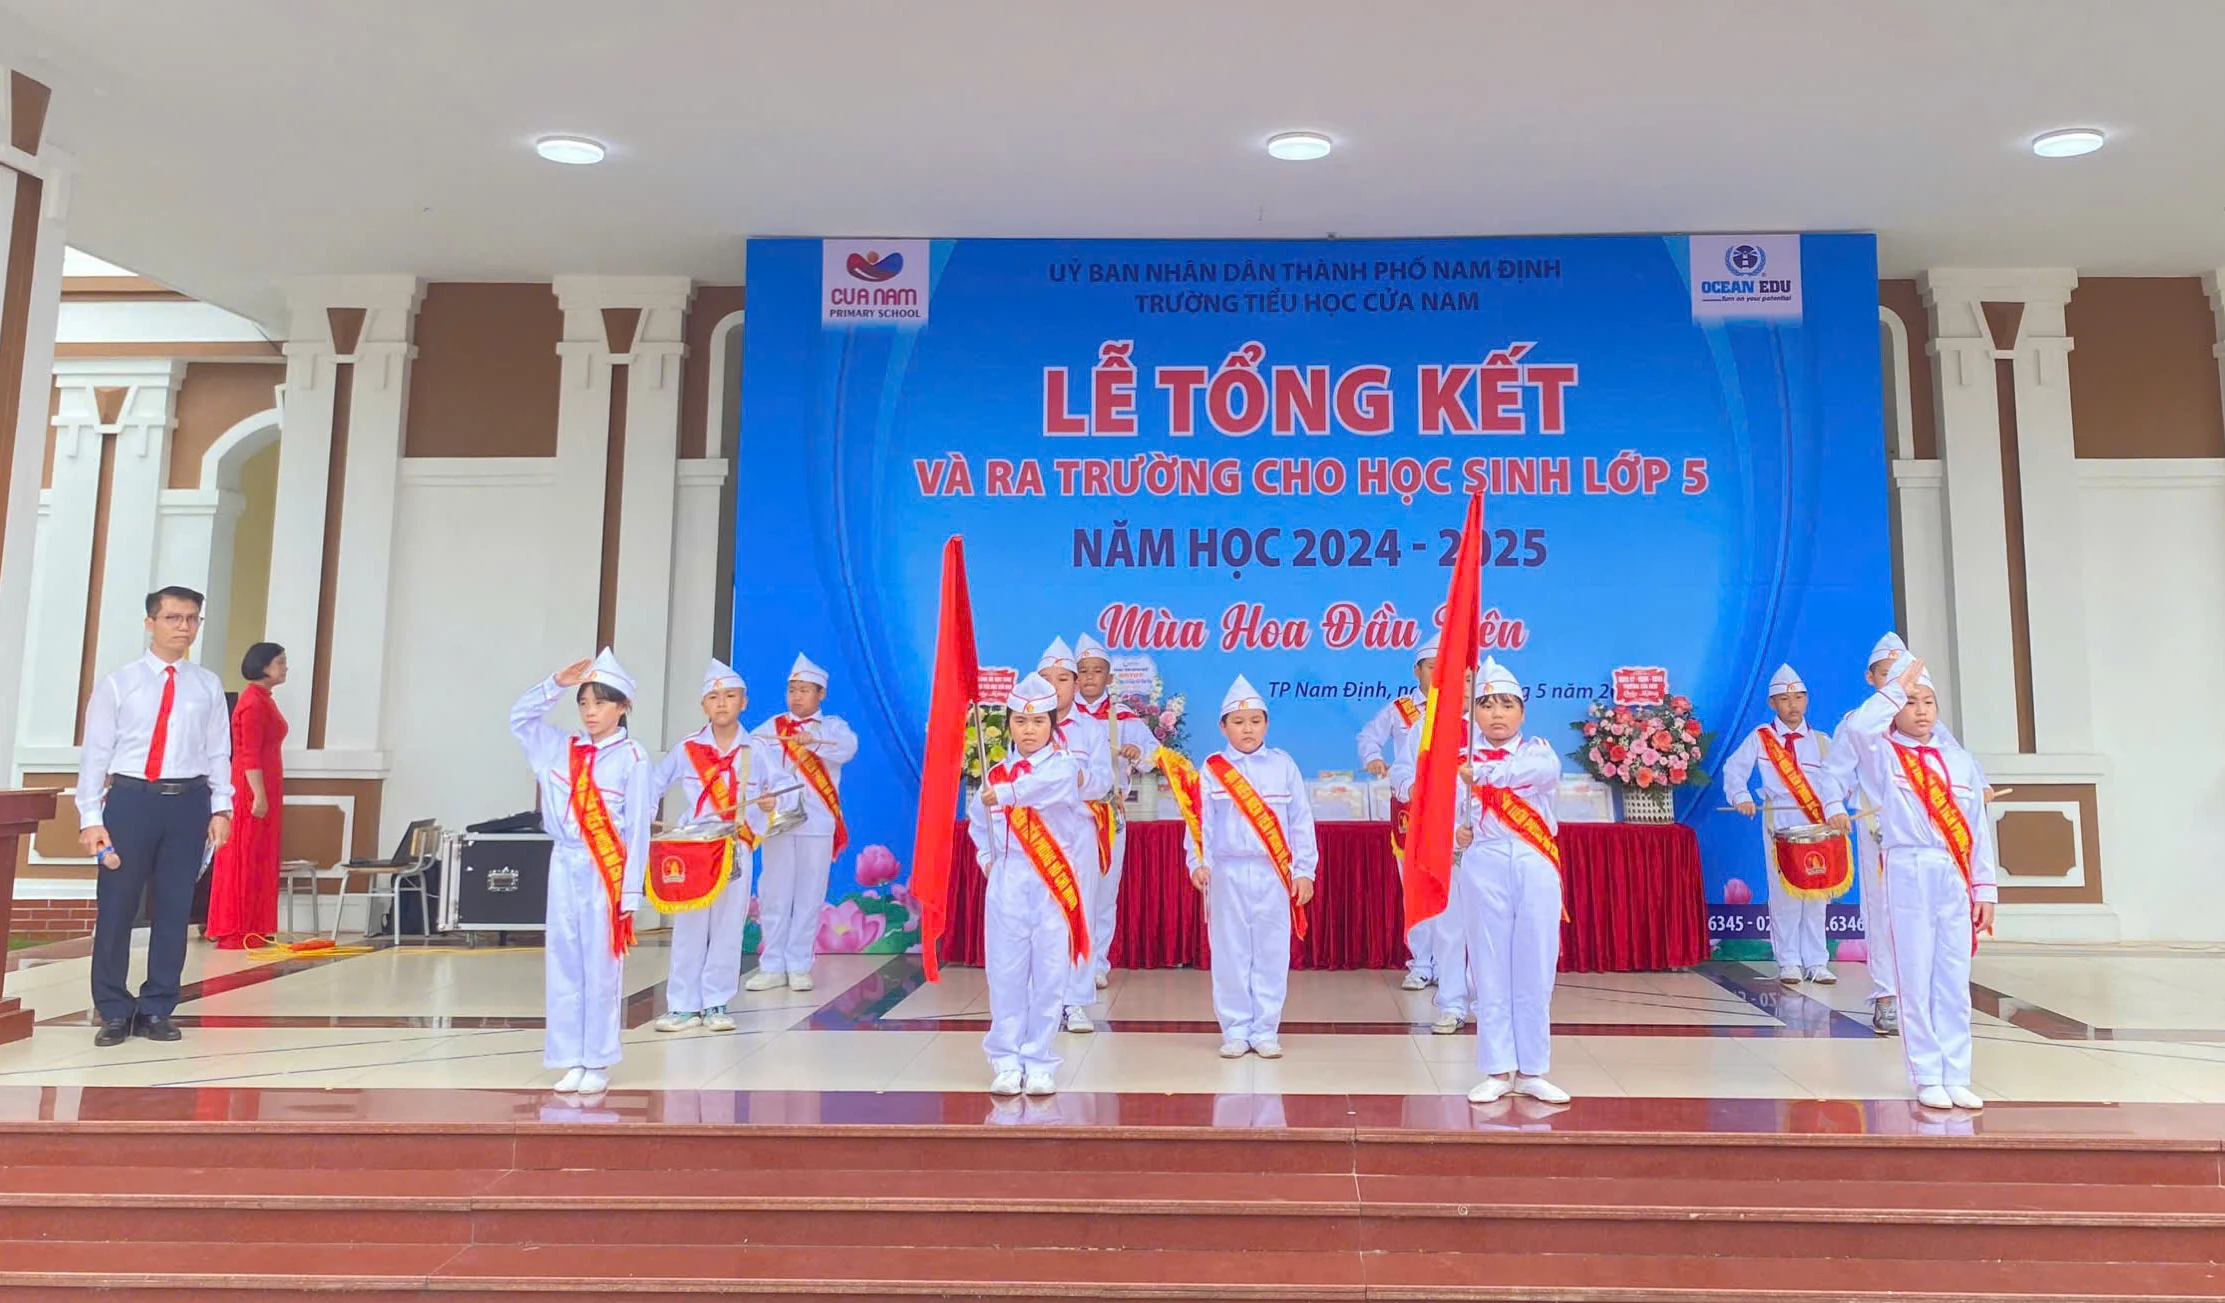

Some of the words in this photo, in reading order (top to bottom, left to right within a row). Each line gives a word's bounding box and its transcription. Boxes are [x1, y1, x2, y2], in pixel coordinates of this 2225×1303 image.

[1050, 258, 1081, 282] UỶ
[1089, 263, 1139, 282] BAN
[1146, 259, 1216, 282] NHÂN
[1281, 258, 1366, 281] THÀNH
[1374, 256, 1427, 280] PHỐ
[1433, 260, 1491, 280] NAM
[1498, 259, 1561, 283] ĐỊNH
[831, 288, 869, 305] CUA
[1702, 280, 1755, 293] OCEAN
[1759, 280, 1791, 293] EDU
[830, 309, 875, 318] PRIMARY
[878, 309, 921, 318] SCHOOL
[1135, 289, 1238, 312] TRƯỜNG
[1245, 287, 1297, 312] TIỂU
[1304, 294, 1356, 318] HỌC
[1364, 288, 1414, 312] CỬA
[1422, 292, 1479, 311] NAM
[1043, 340, 1138, 438] LỄ
[1156, 340, 1394, 437] TỔNG
[1417, 341, 1578, 436] KẾT
[914, 451, 973, 497] VÀ
[986, 458, 1045, 497] RA
[1055, 451, 1241, 496] TRƯỜNG
[1252, 457, 1346, 496] CHO
[1358, 457, 1452, 506] HỌC
[1463, 456, 1570, 495] SINH
[1583, 449, 1670, 495] LỚP
[1682, 457, 1708, 495] 5
[1073, 519, 1175, 567] NĂM
[1189, 528, 1281, 580] HỌC
[1292, 528, 1402, 567] 2024
[1411, 542, 1427, 551] -
[1099, 602, 1208, 651] Mùa
[1220, 602, 1310, 651] Hoa
[1321, 601, 1420, 651] Đầu
[1433, 603, 1530, 651] ên
[1269, 682, 1291, 697] TP
[1295, 682, 1338, 698] Nam
[1343, 681, 1391, 701] Định,
[1536, 683, 1548, 699] 5
[1552, 682, 1593, 699] năm
[1708, 915, 1744, 931] 6345
